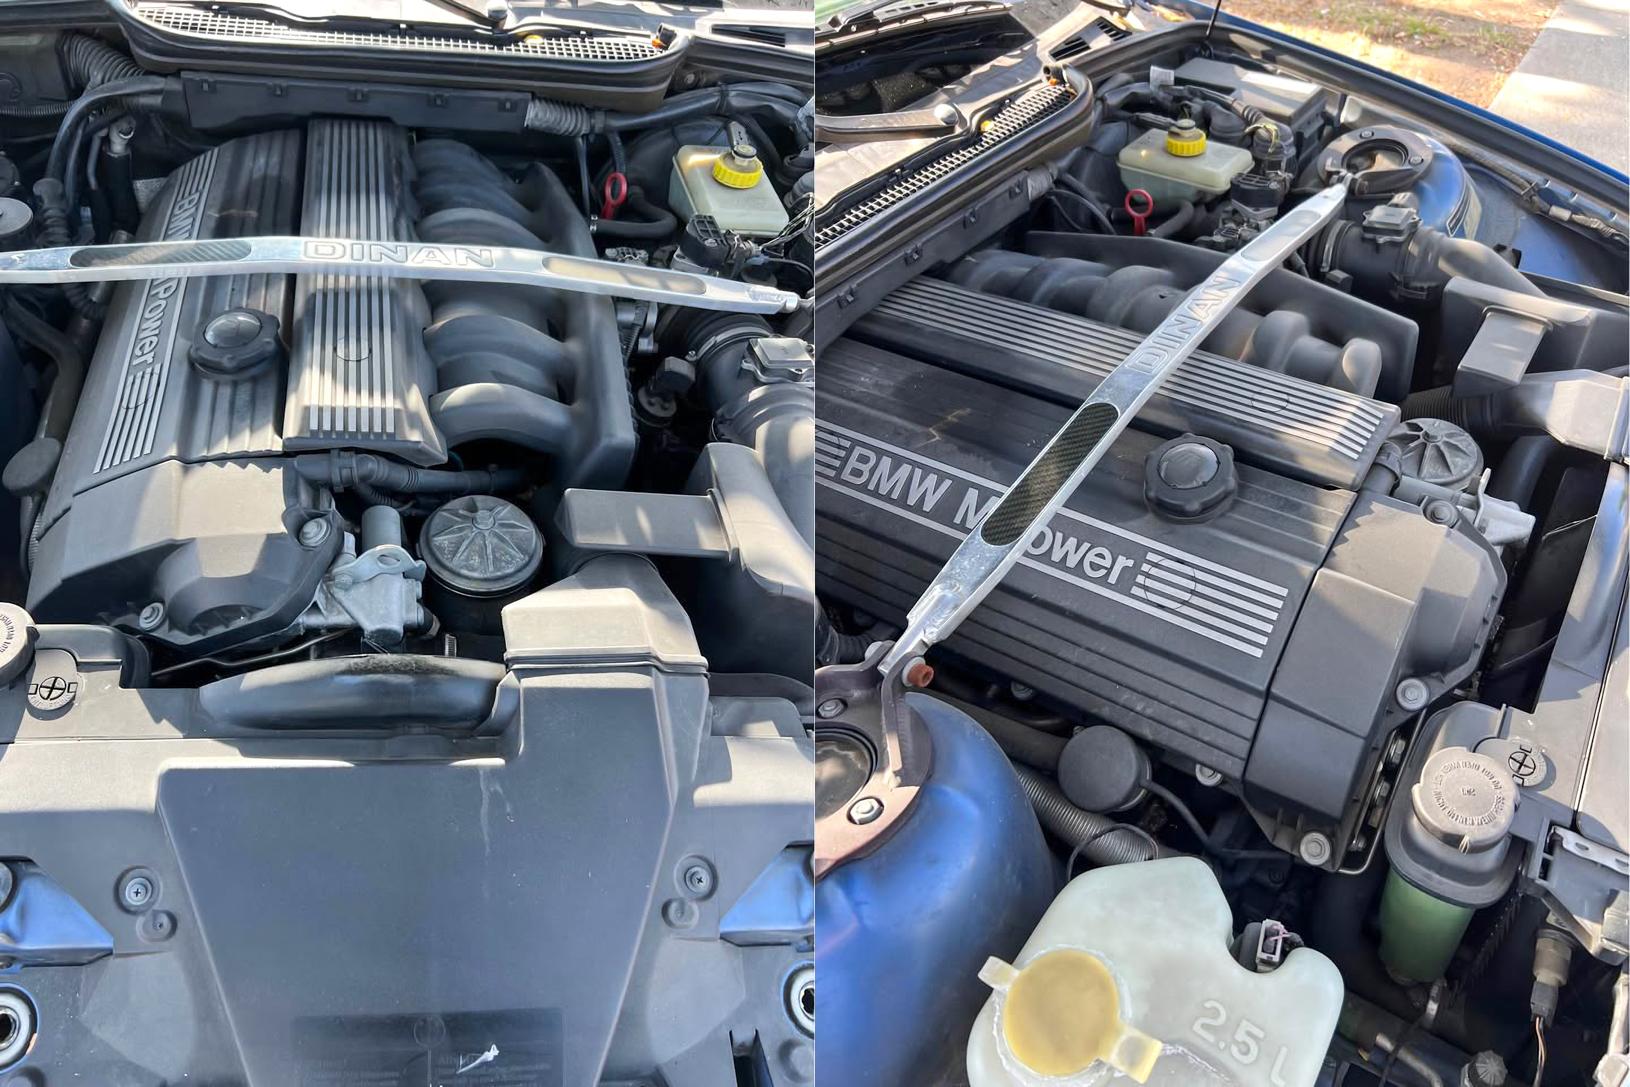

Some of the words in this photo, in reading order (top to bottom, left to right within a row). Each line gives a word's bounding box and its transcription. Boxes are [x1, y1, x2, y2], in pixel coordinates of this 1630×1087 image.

[303, 240, 496, 269] DINAN
[1125, 275, 1241, 375] DINAN
[841, 446, 952, 512] BMW
[1027, 526, 1135, 584] ower
[1192, 1000, 1264, 1065] 2.5
[1270, 1046, 1288, 1087] L
